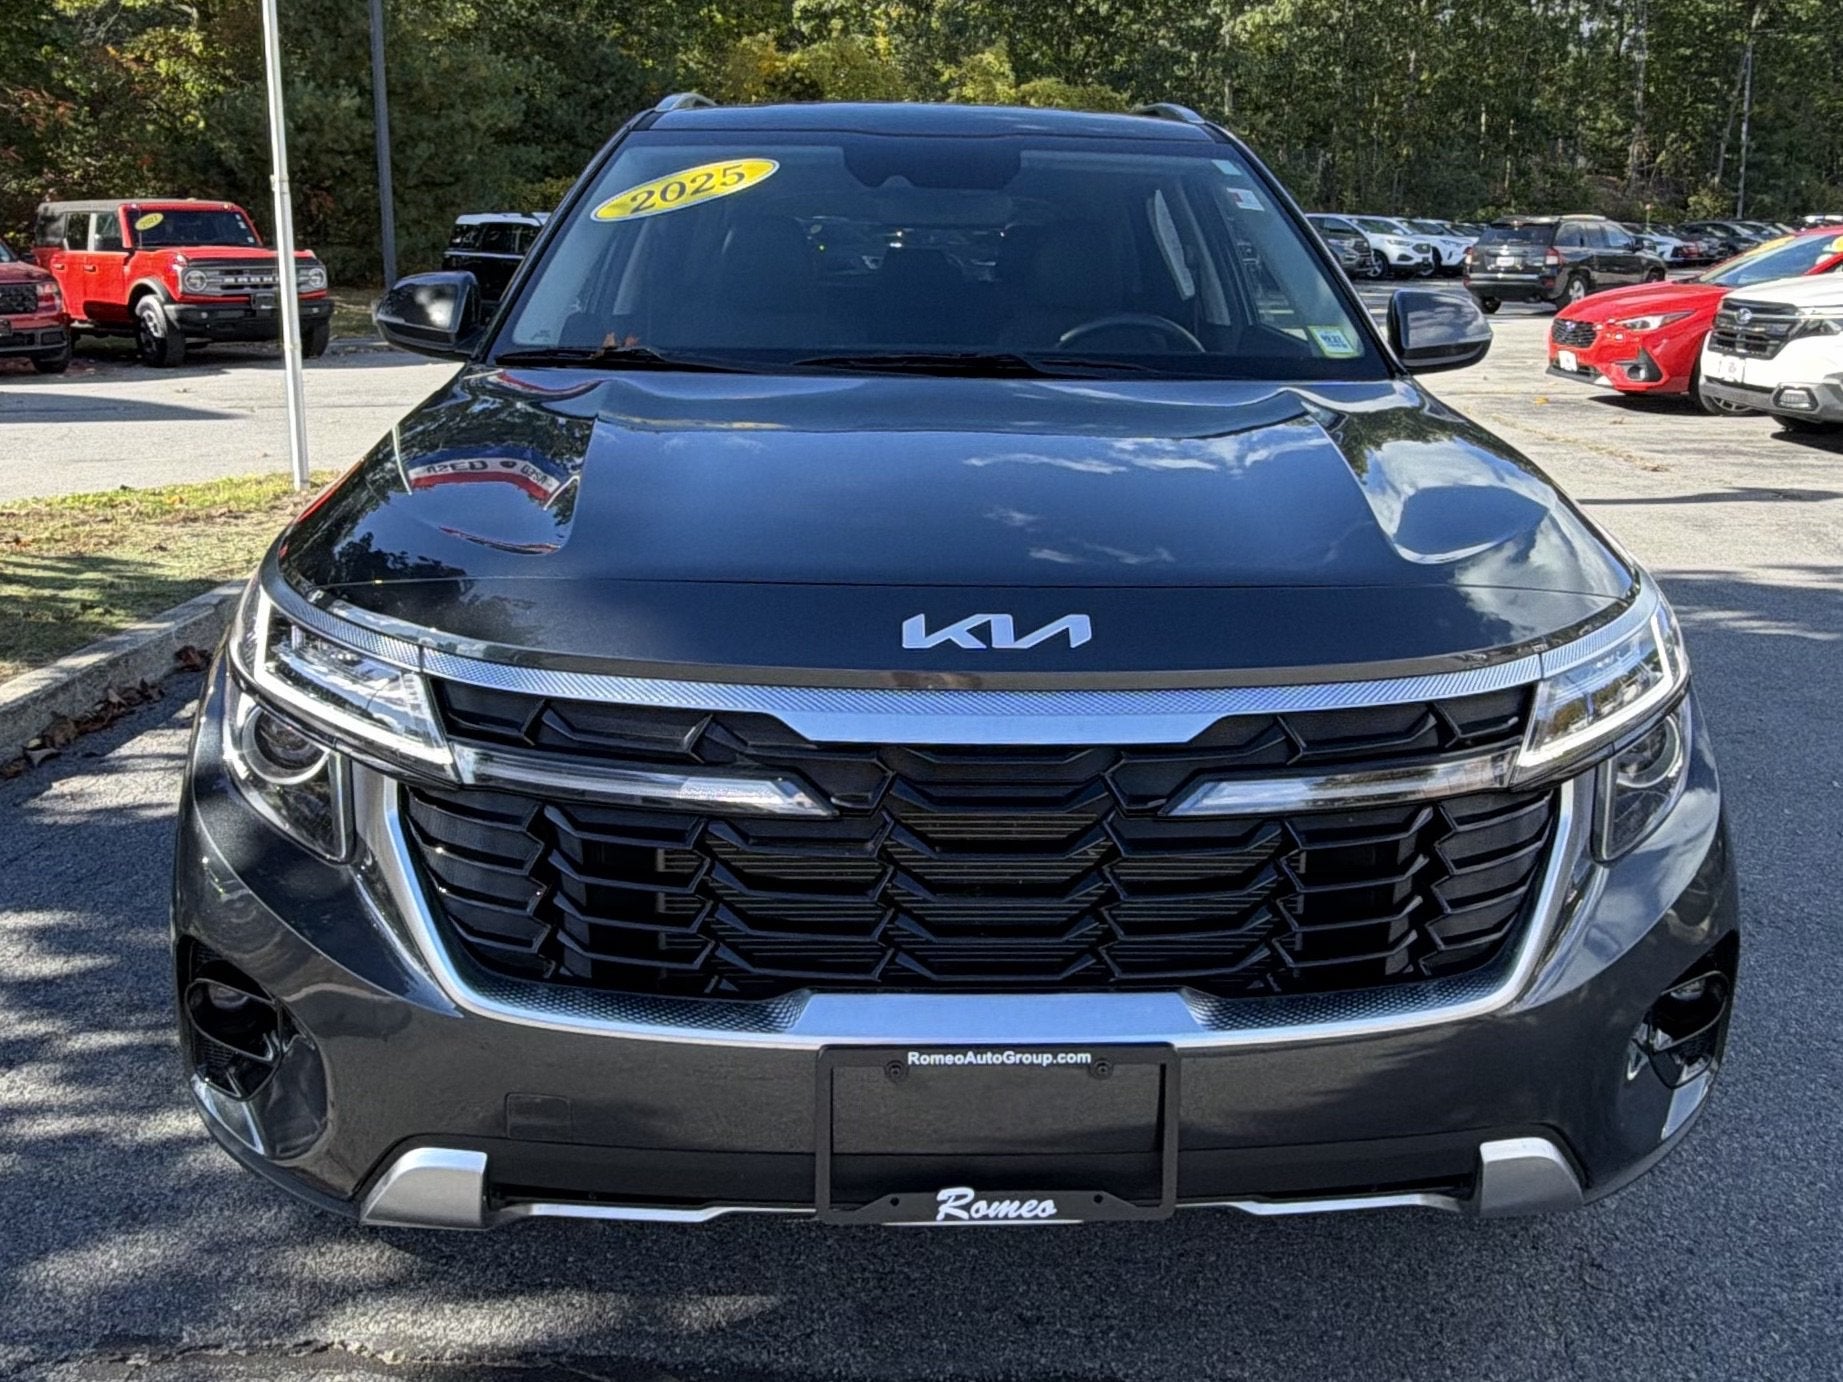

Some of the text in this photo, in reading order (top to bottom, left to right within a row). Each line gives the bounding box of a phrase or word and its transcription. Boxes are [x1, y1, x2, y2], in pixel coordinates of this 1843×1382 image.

[630, 164, 746, 214] 2025
[902, 612, 1092, 649] KIA
[907, 1051, 1092, 1067] RomeoAutoGroup.com
[936, 1186, 1058, 1221] Romeo
